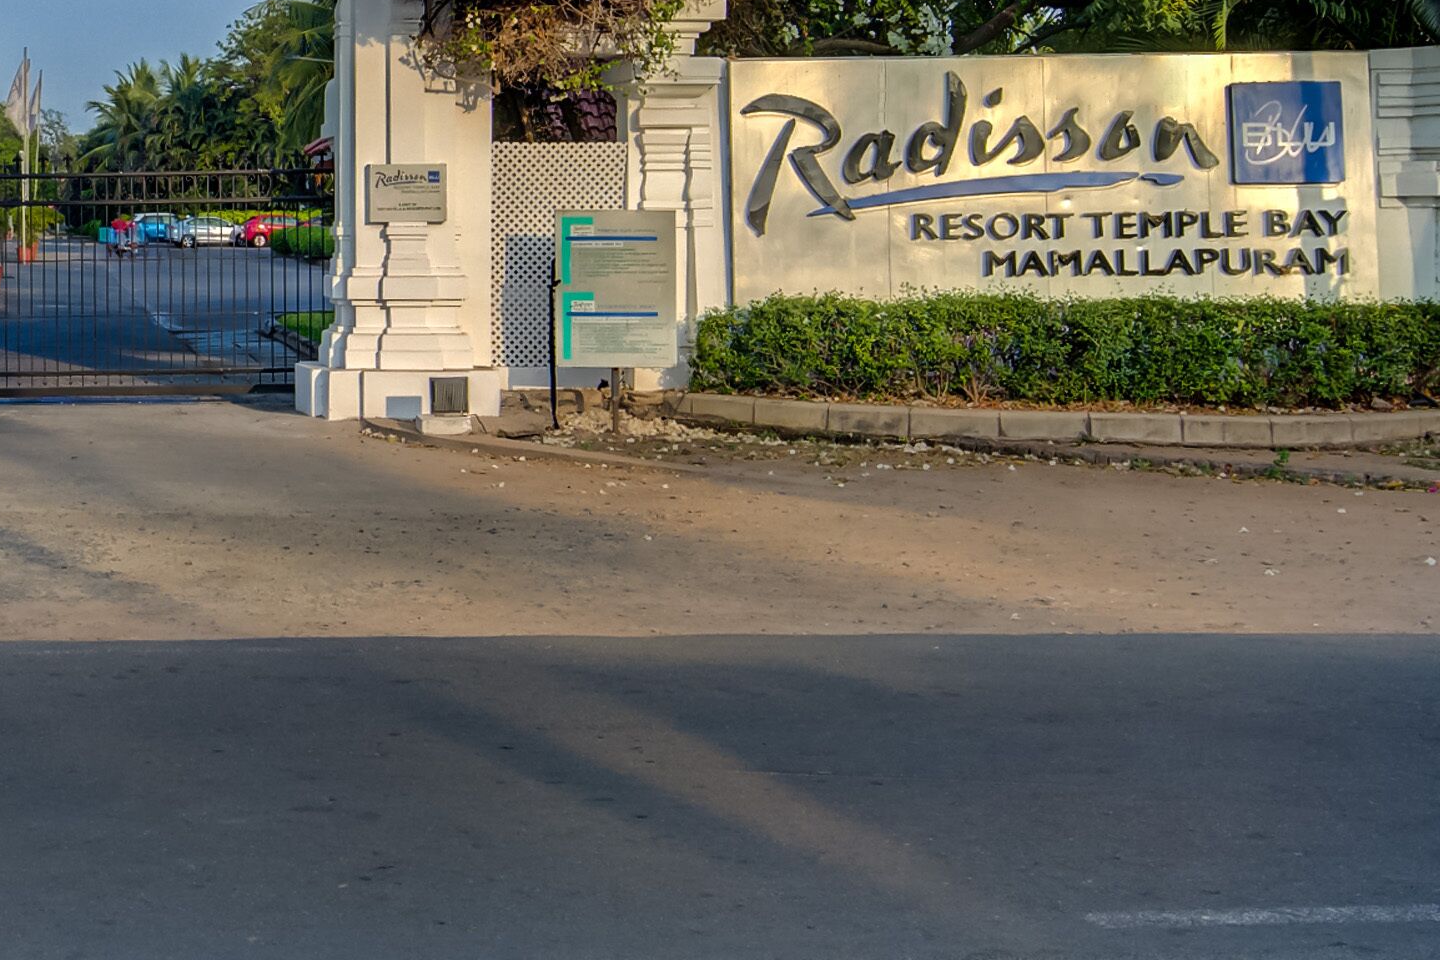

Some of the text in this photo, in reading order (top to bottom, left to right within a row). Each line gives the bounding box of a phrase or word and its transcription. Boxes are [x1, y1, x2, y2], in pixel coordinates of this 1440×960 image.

[740, 71, 1220, 238] Radisson
[910, 209, 1348, 241] RESORT TEMPLE BAY
[981, 246, 1350, 278] MAMALLAPURAM
